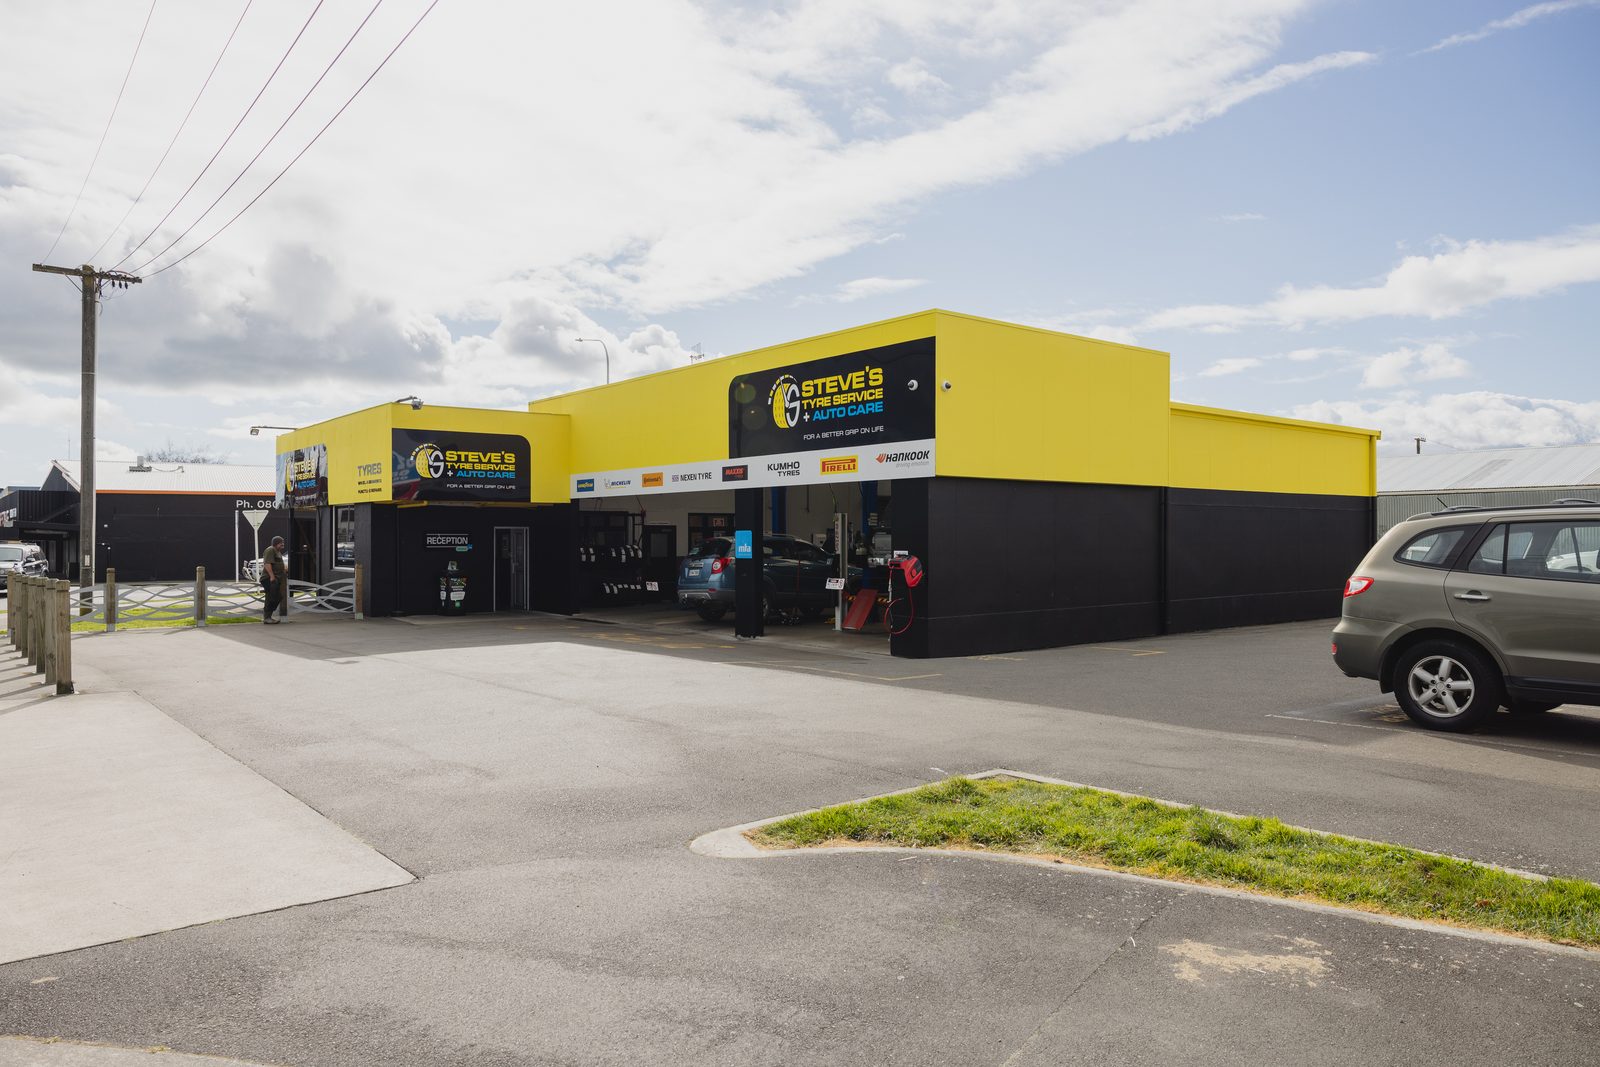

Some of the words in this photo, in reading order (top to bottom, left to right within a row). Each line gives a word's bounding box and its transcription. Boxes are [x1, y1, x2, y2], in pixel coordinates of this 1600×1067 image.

[801, 366, 884, 397] STEVE'S
[802, 396, 832, 410] TYRE
[832, 388, 884, 405] SERVICE
[812, 406, 846, 421] AUTO
[847, 401, 884, 416] CARE
[821, 430, 844, 438] BETTER
[445, 450, 516, 464] STEVE'S
[357, 462, 382, 477] TYRES
[446, 462, 473, 470] TYRE
[473, 463, 516, 471] SERVICE
[767, 461, 800, 471] KUMHO
[821, 458, 857, 473] PIRELLI
[456, 470, 486, 478] AUTO
[486, 471, 516, 479] CARE
[697, 472, 712, 480] TYRE
[777, 469, 801, 477] TYRES
[236, 500, 254, 508] Ph.
[426, 536, 468, 545] RECEPTION
